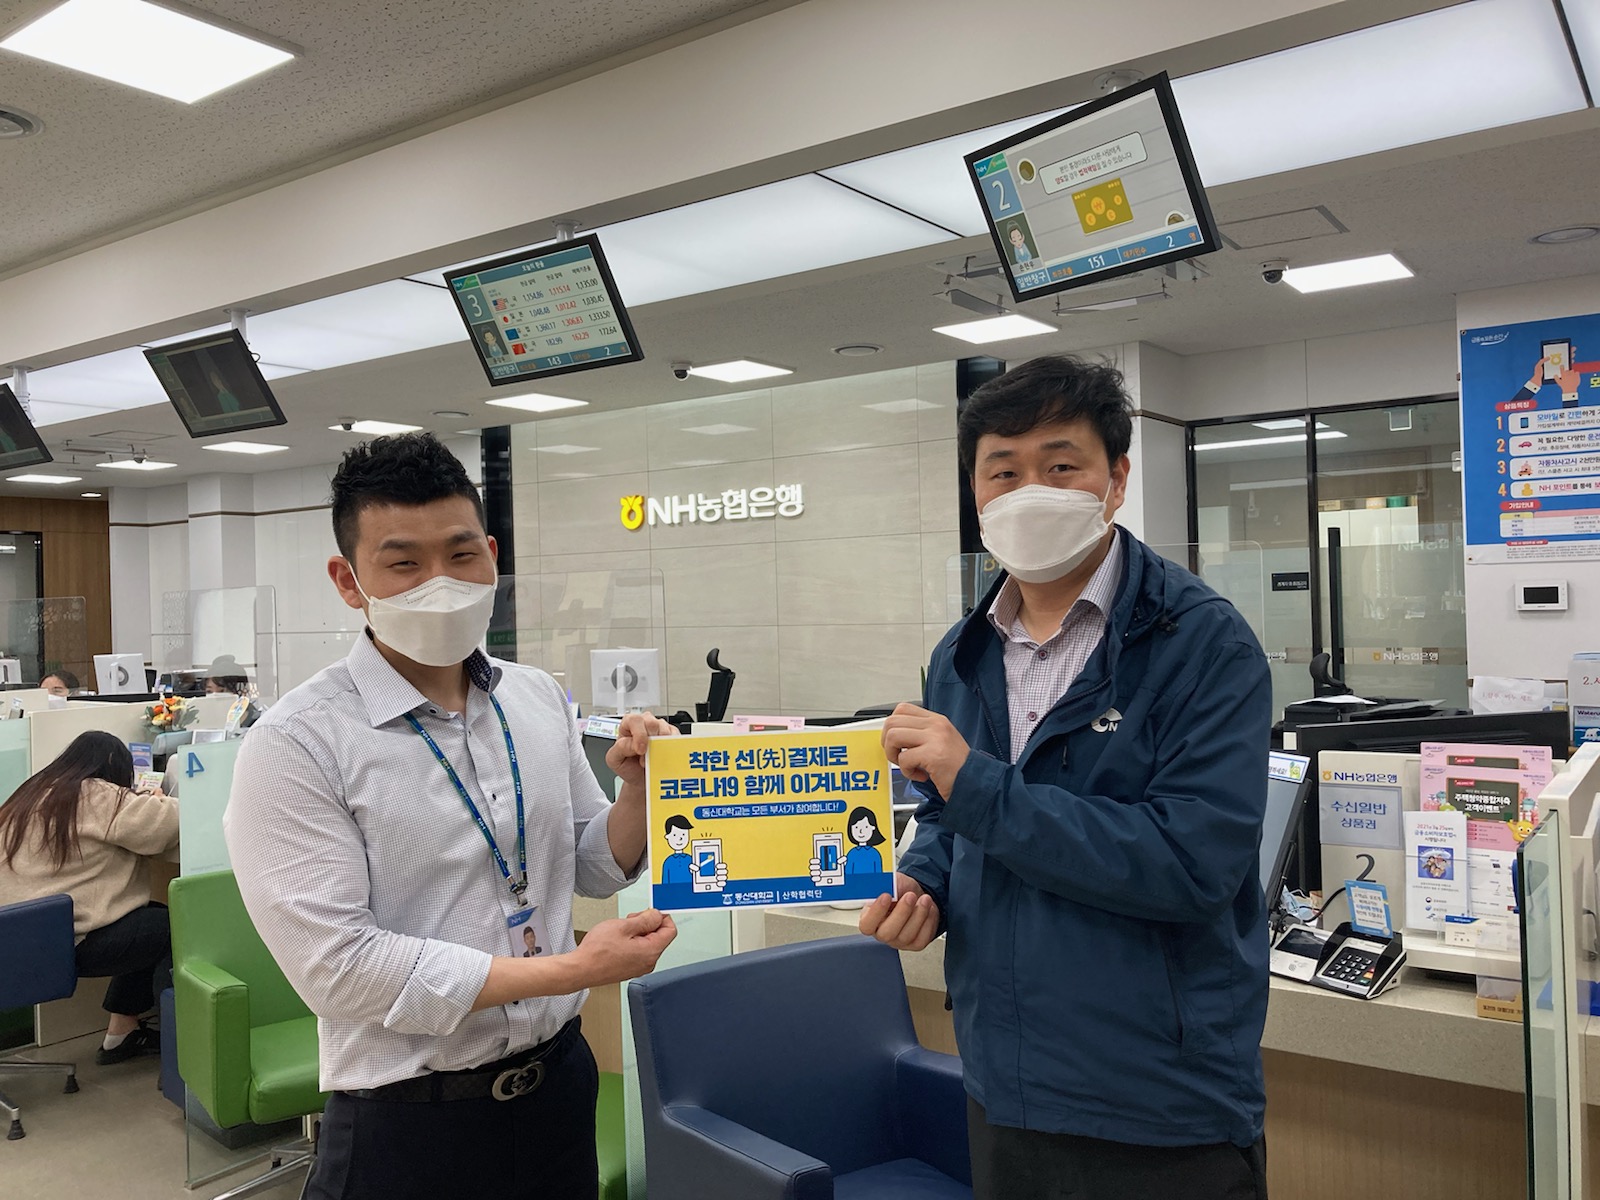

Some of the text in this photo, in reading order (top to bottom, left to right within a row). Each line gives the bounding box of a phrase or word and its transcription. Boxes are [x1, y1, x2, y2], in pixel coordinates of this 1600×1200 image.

[992, 180, 1010, 212] 2
[1166, 236, 1176, 248] 2
[1088, 255, 1106, 269] 151
[1017, 272, 1046, 288] 일반창구
[466, 294, 482, 318] 3
[604, 346, 612, 356] 2
[547, 356, 562, 366] 143
[1537, 414, 1566, 422] 모바일로
[1568, 408, 1596, 419] 간편하게
[1496, 438, 1506, 452] 2
[1497, 460, 1506, 474] 3
[1498, 483, 1507, 497] 4
[1552, 484, 1578, 492] 포인트를
[648, 484, 804, 526] NH농협은행
[1383, 652, 1439, 662] NH농협은행
[420, 729, 432, 742] NH
[688, 751, 731, 772] 착한
[660, 770, 880, 800] 코로나19 함께 이겨내요!
[1334, 772, 1398, 784] NH농협은행
[516, 782, 522, 794] NH
[701, 802, 840, 818] 동신대학교는 모든 부서가 참여합니다!
[1330, 800, 1387, 816] 수신일반
[477, 817, 486, 830] NH
[1340, 817, 1376, 830] 상품권
[1356, 853, 1377, 883] 2
[734, 890, 822, 900] 동신대학교 산학협력단
